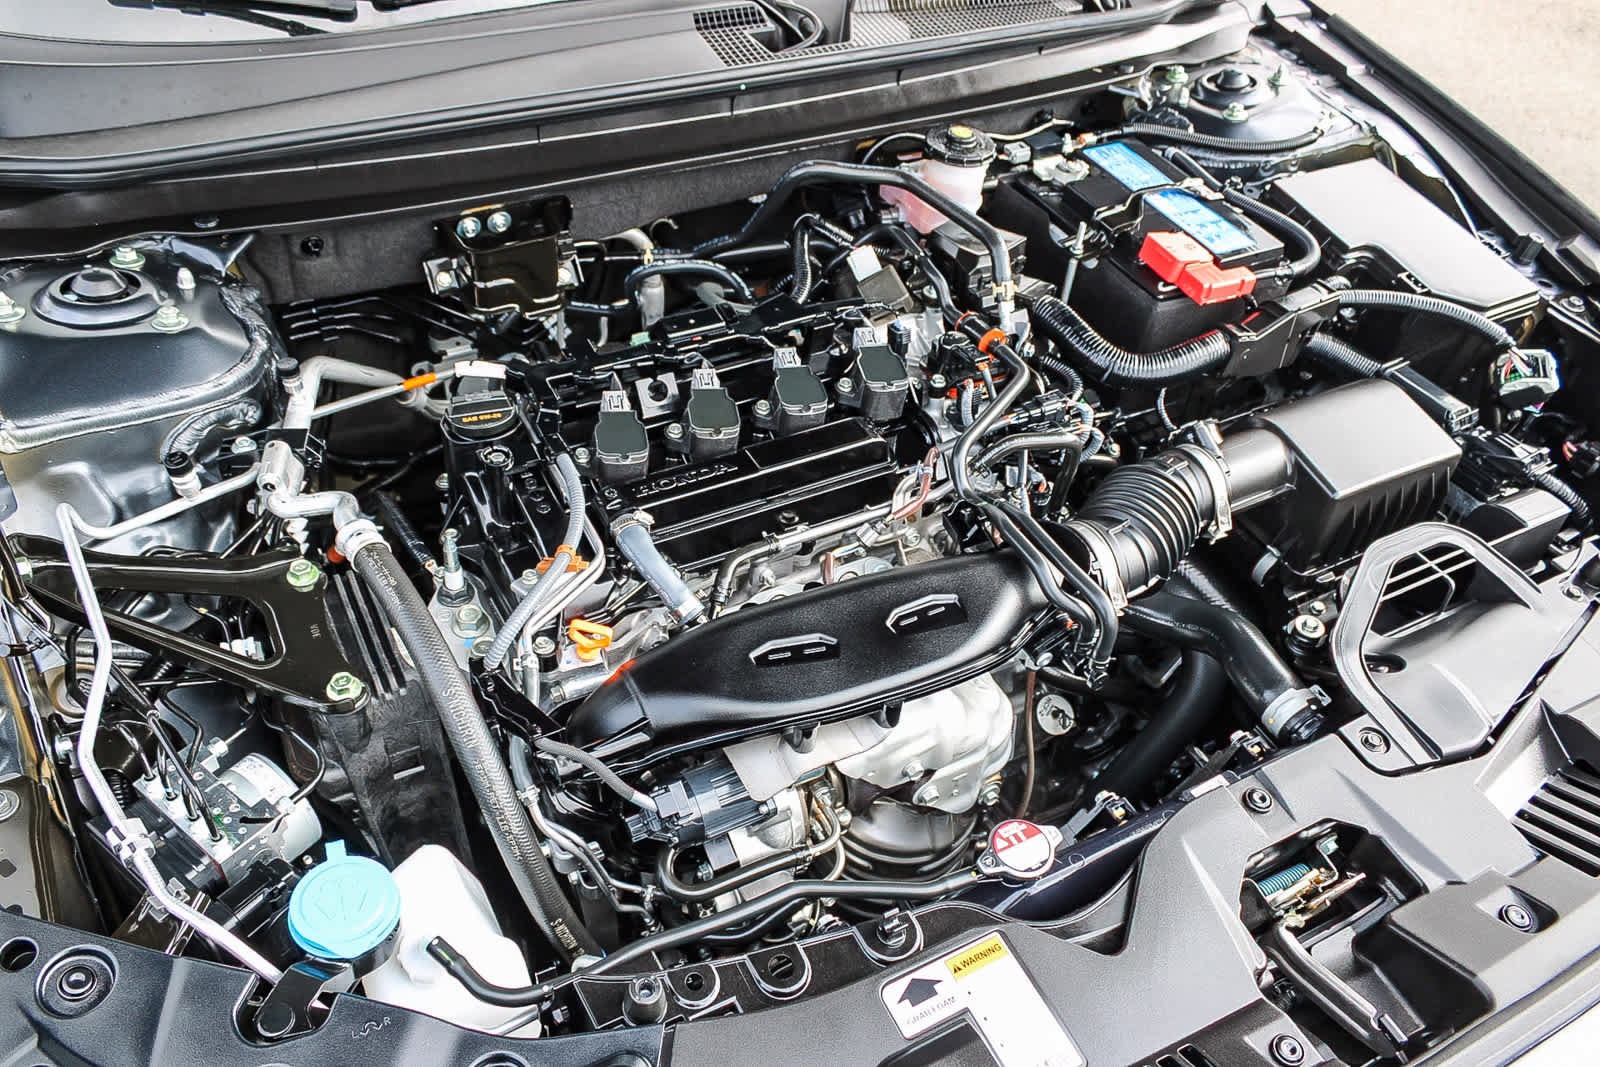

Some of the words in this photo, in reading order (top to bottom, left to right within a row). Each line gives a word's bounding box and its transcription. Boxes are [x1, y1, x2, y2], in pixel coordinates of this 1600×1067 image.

[631, 464, 739, 498] HONDA
[961, 943, 1002, 968] WARNING
[383, 1017, 391, 1026] R
